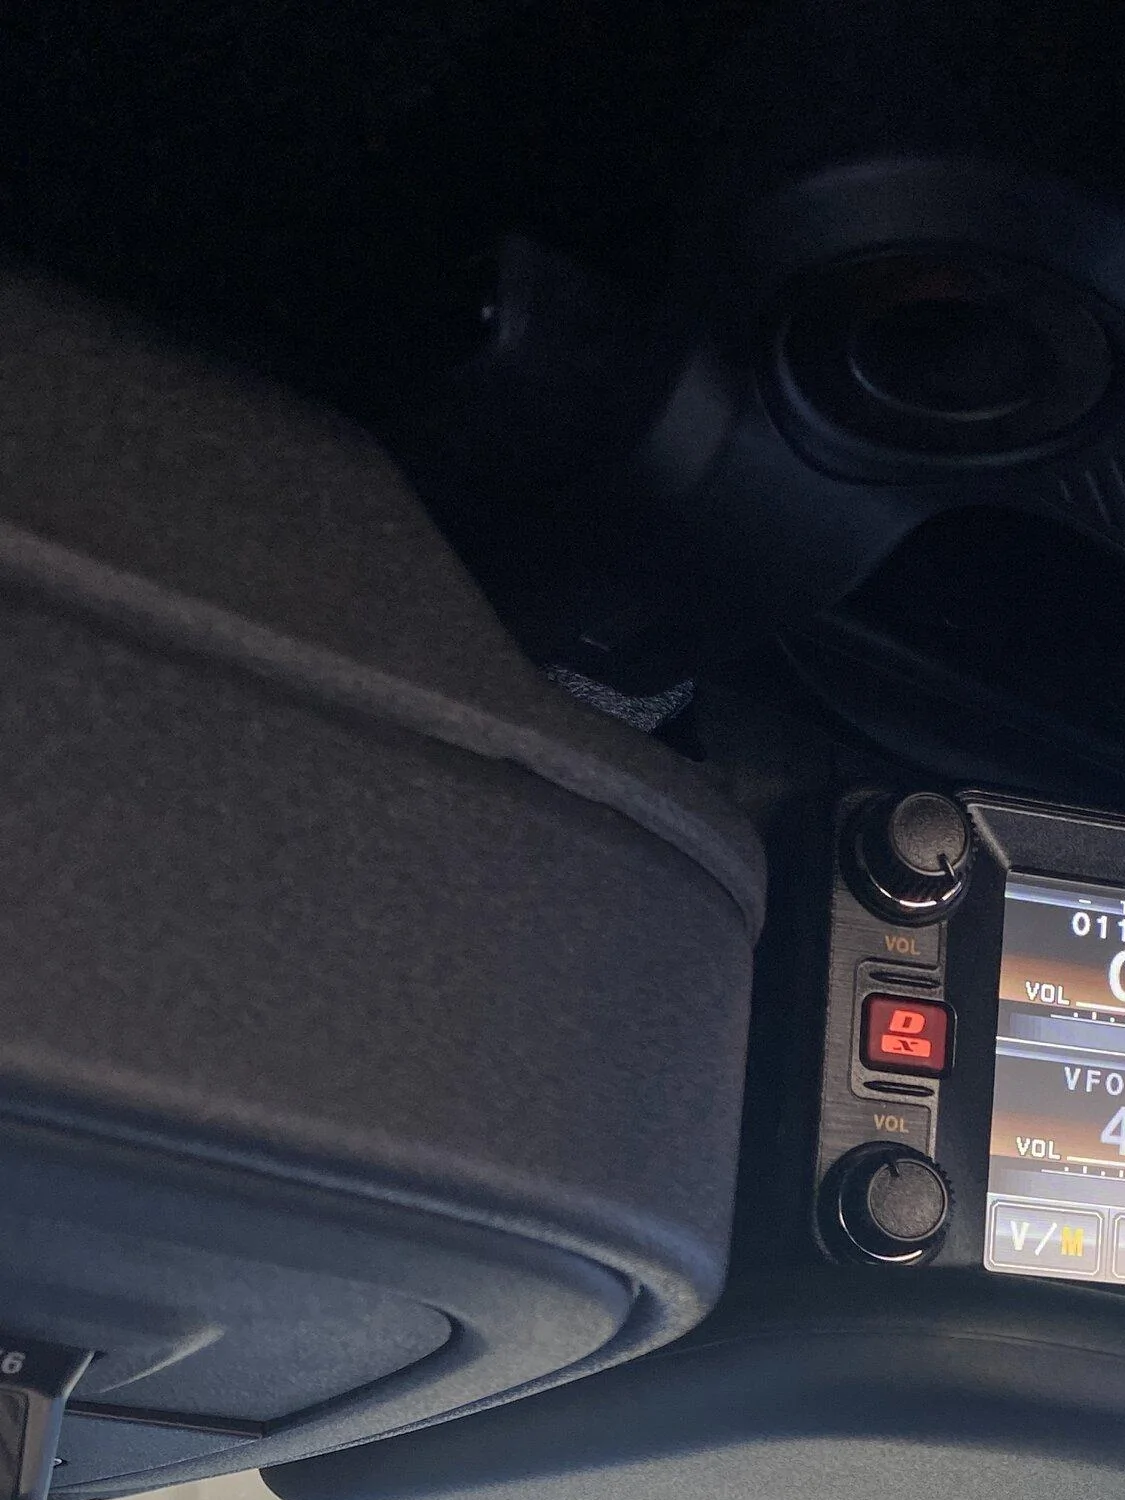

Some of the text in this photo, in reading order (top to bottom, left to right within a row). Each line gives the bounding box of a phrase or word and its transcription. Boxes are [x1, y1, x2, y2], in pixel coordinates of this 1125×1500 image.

[884, 934, 922, 957] VOL
[1025, 981, 1071, 1007] VOL
[889, 1010, 926, 1034] D
[1064, 1066, 1125, 1096] VFO
[873, 1113, 910, 1134] VOL
[1016, 1137, 1062, 1161] VOL
[1010, 1221, 1084, 1257] V/M
